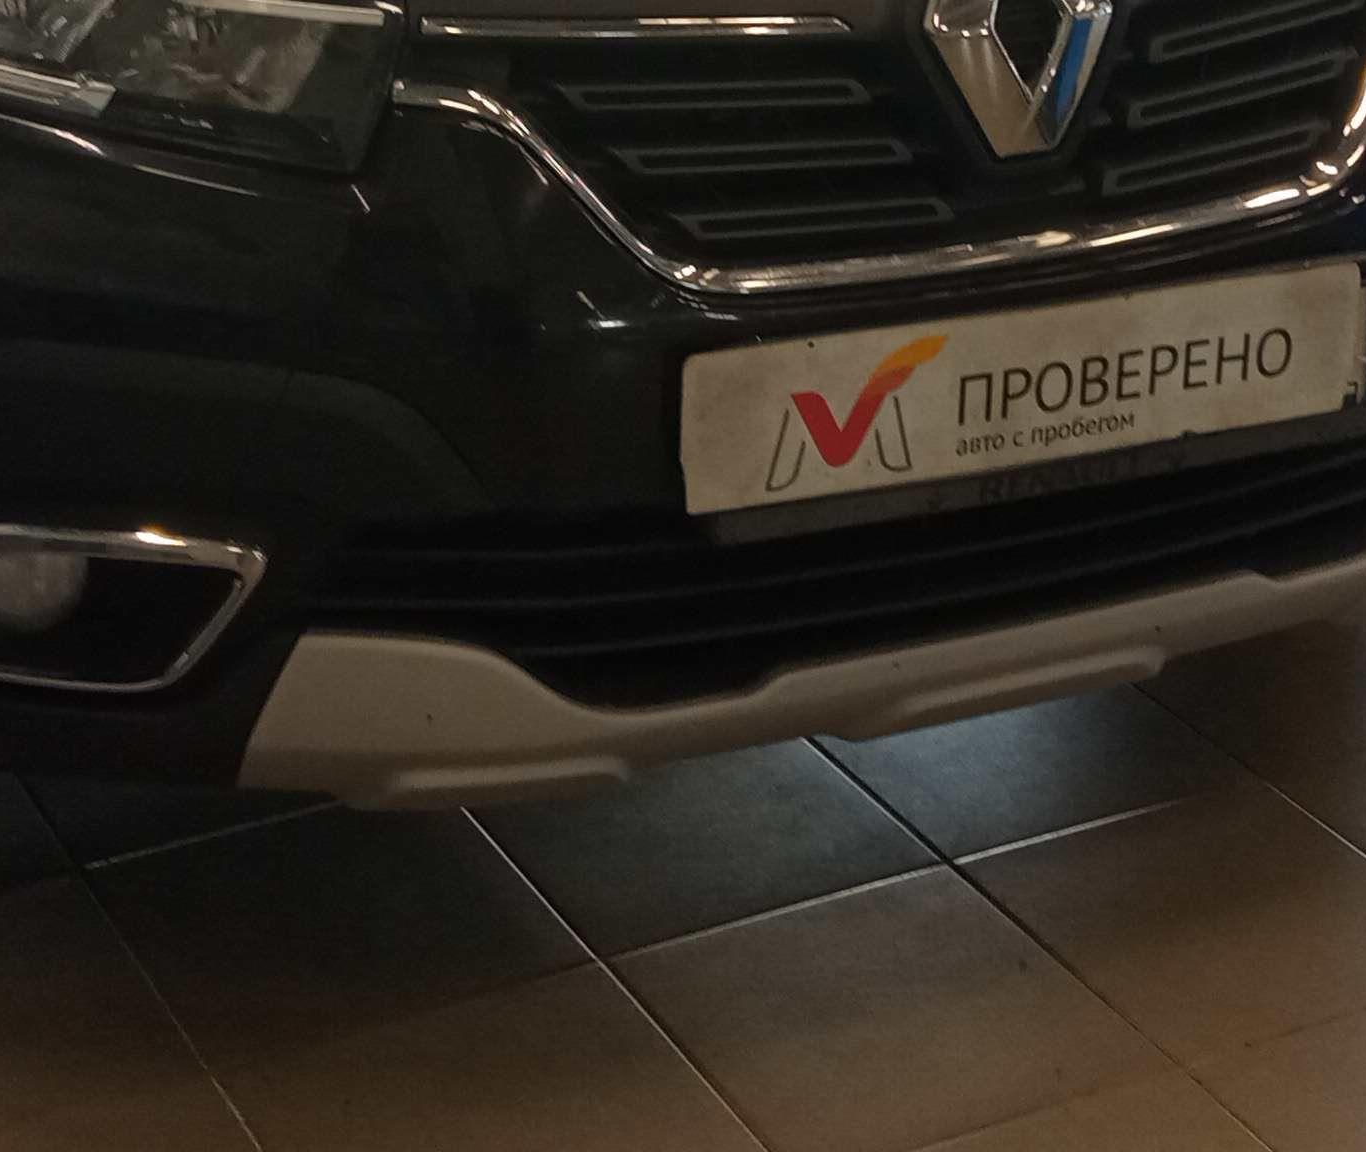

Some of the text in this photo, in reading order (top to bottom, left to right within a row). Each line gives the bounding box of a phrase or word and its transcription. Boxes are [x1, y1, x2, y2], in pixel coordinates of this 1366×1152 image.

[957, 327, 1293, 427] ПРОВЕРЕНО
[955, 412, 1135, 457] авто с пробегом
